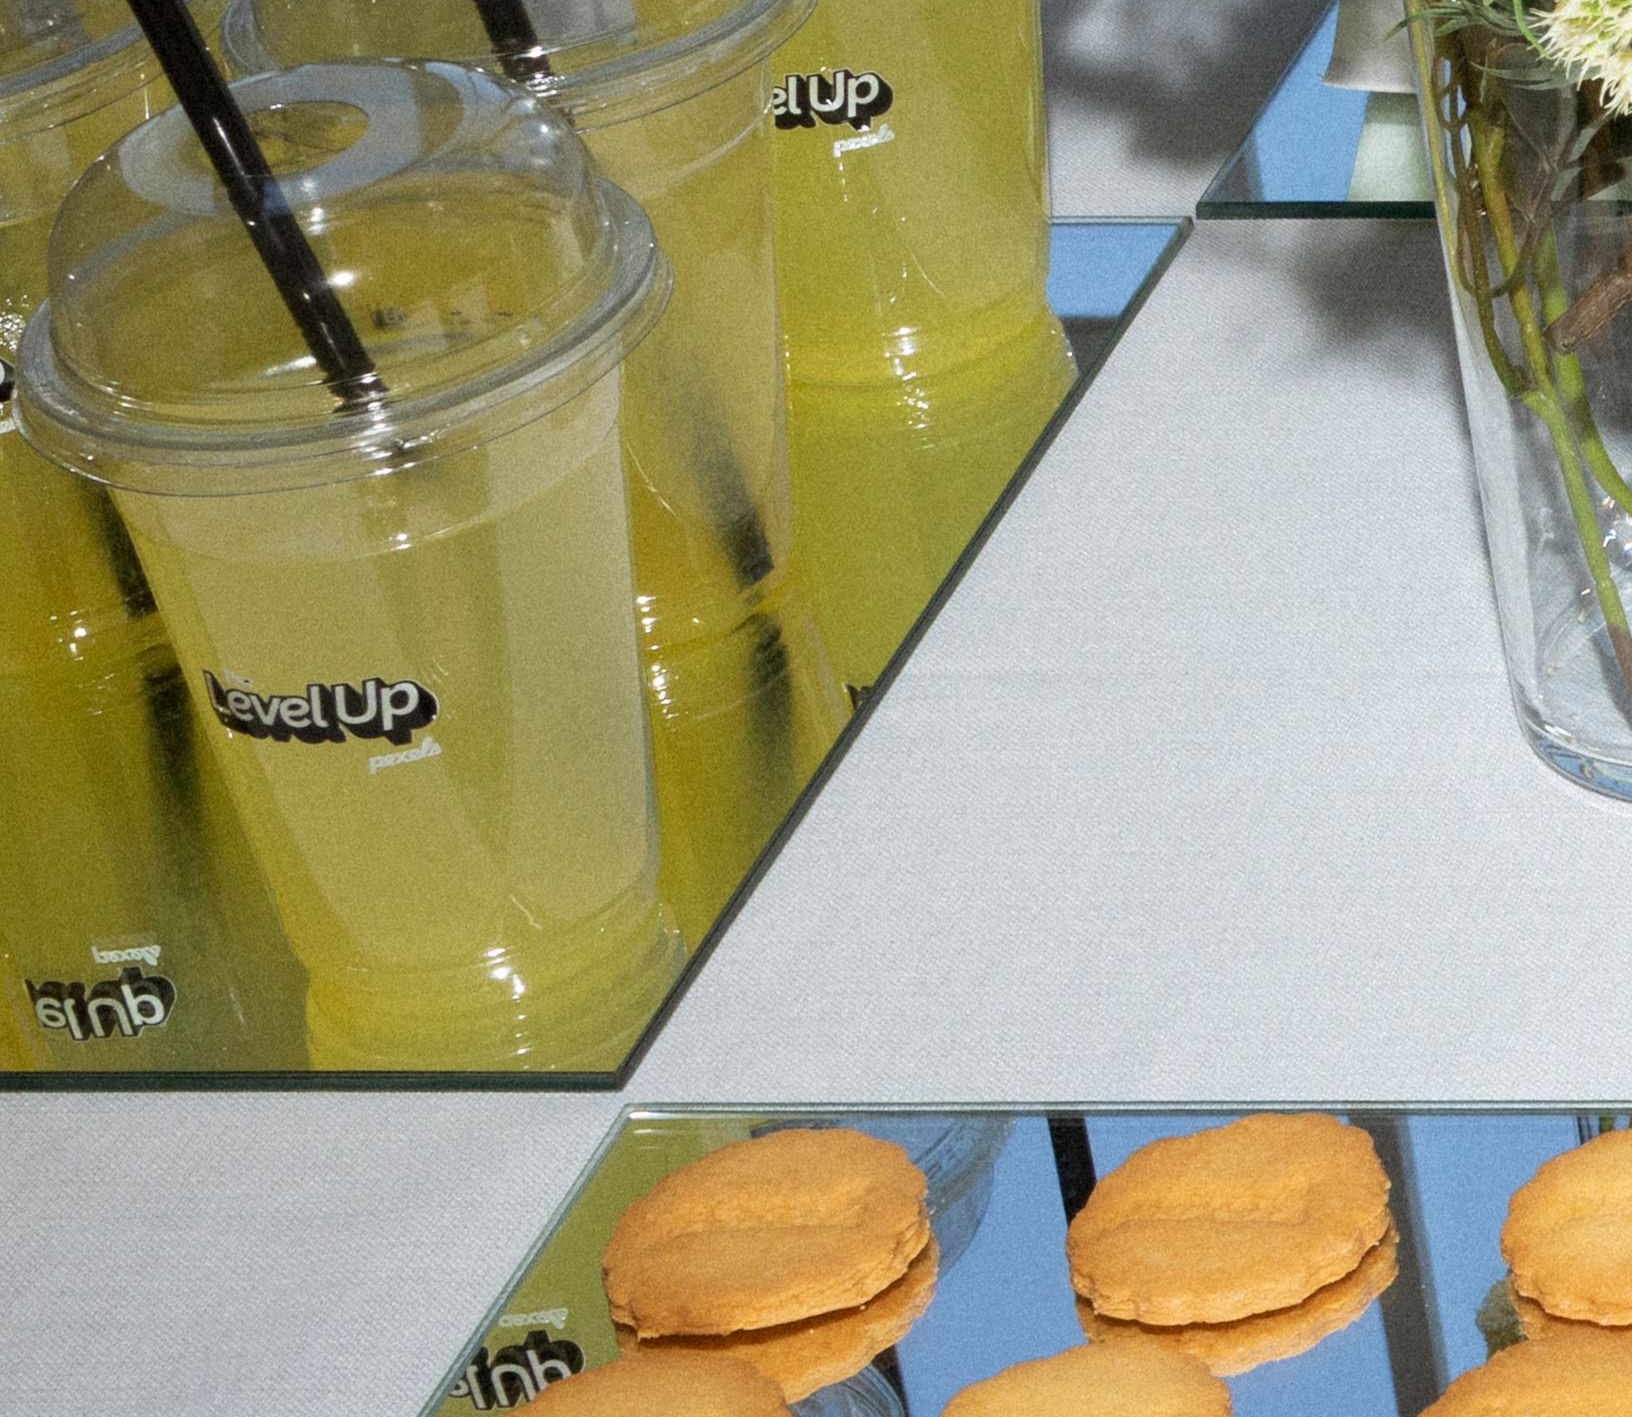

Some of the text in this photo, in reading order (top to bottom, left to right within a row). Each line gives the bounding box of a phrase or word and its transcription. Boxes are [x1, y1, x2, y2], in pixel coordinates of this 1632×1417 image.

[807, 70, 884, 122] Up
[203, 668, 423, 734] Level Up
